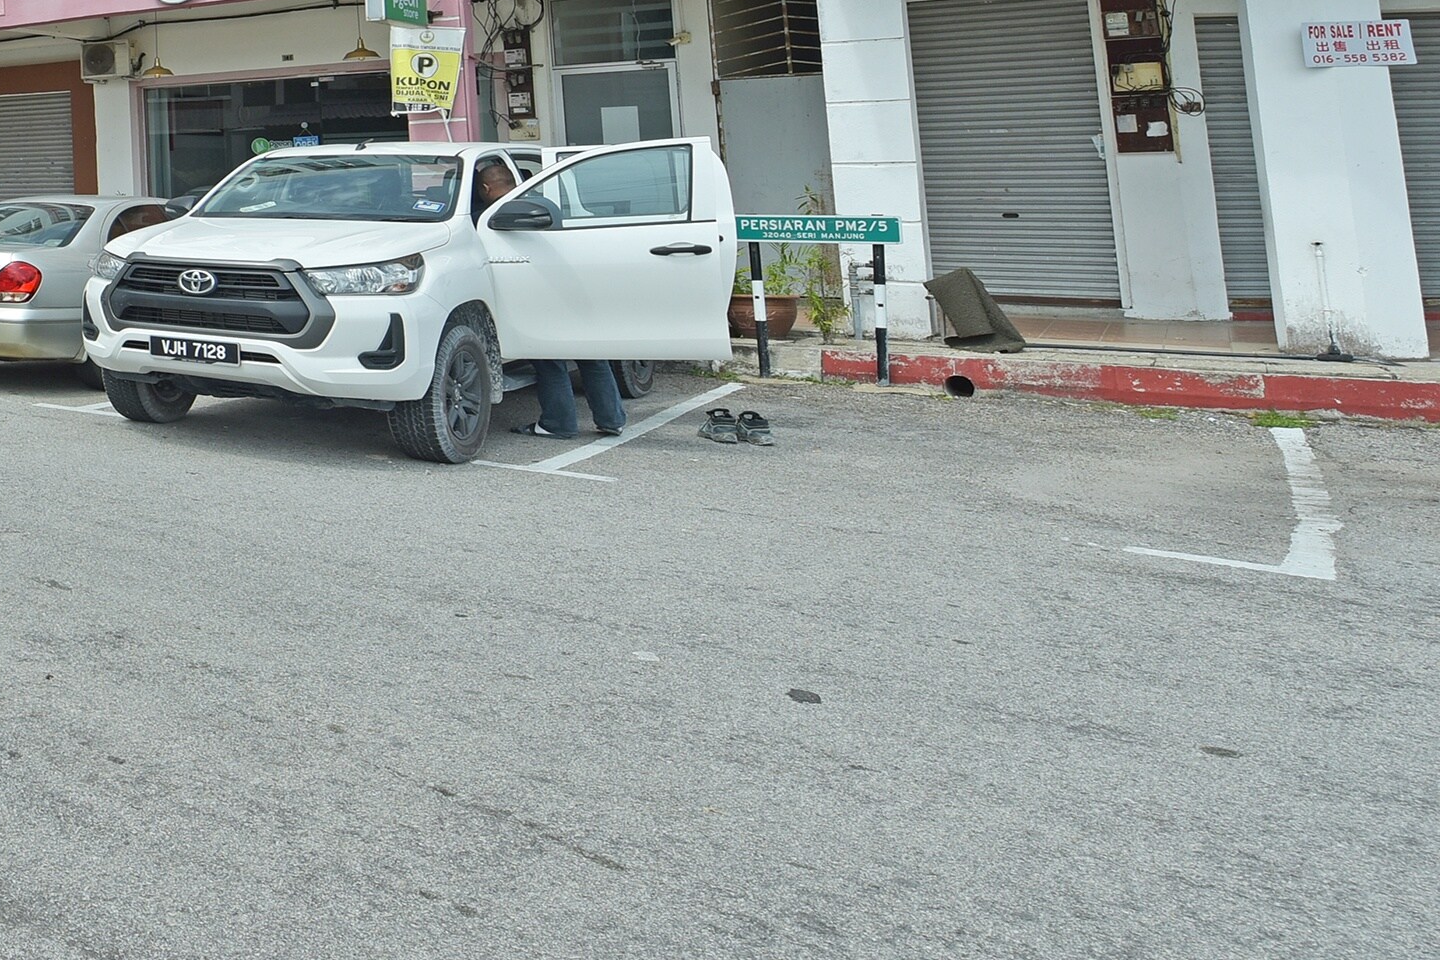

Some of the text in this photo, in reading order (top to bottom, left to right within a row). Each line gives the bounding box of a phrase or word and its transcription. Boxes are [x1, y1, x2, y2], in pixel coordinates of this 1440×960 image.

[403, 8, 419, 20] store
[1308, 25, 1326, 39] FOR
[1330, 25, 1354, 39] SALE
[1366, 23, 1402, 37] RENT
[1316, 39, 1400, 52] 出售 出租
[1372, 52, 1407, 62] 5382
[396, 76, 451, 91] KUPON
[740, 219, 888, 232] PERSIARAN PM2/5
[161, 339, 226, 360] VJH 7128
